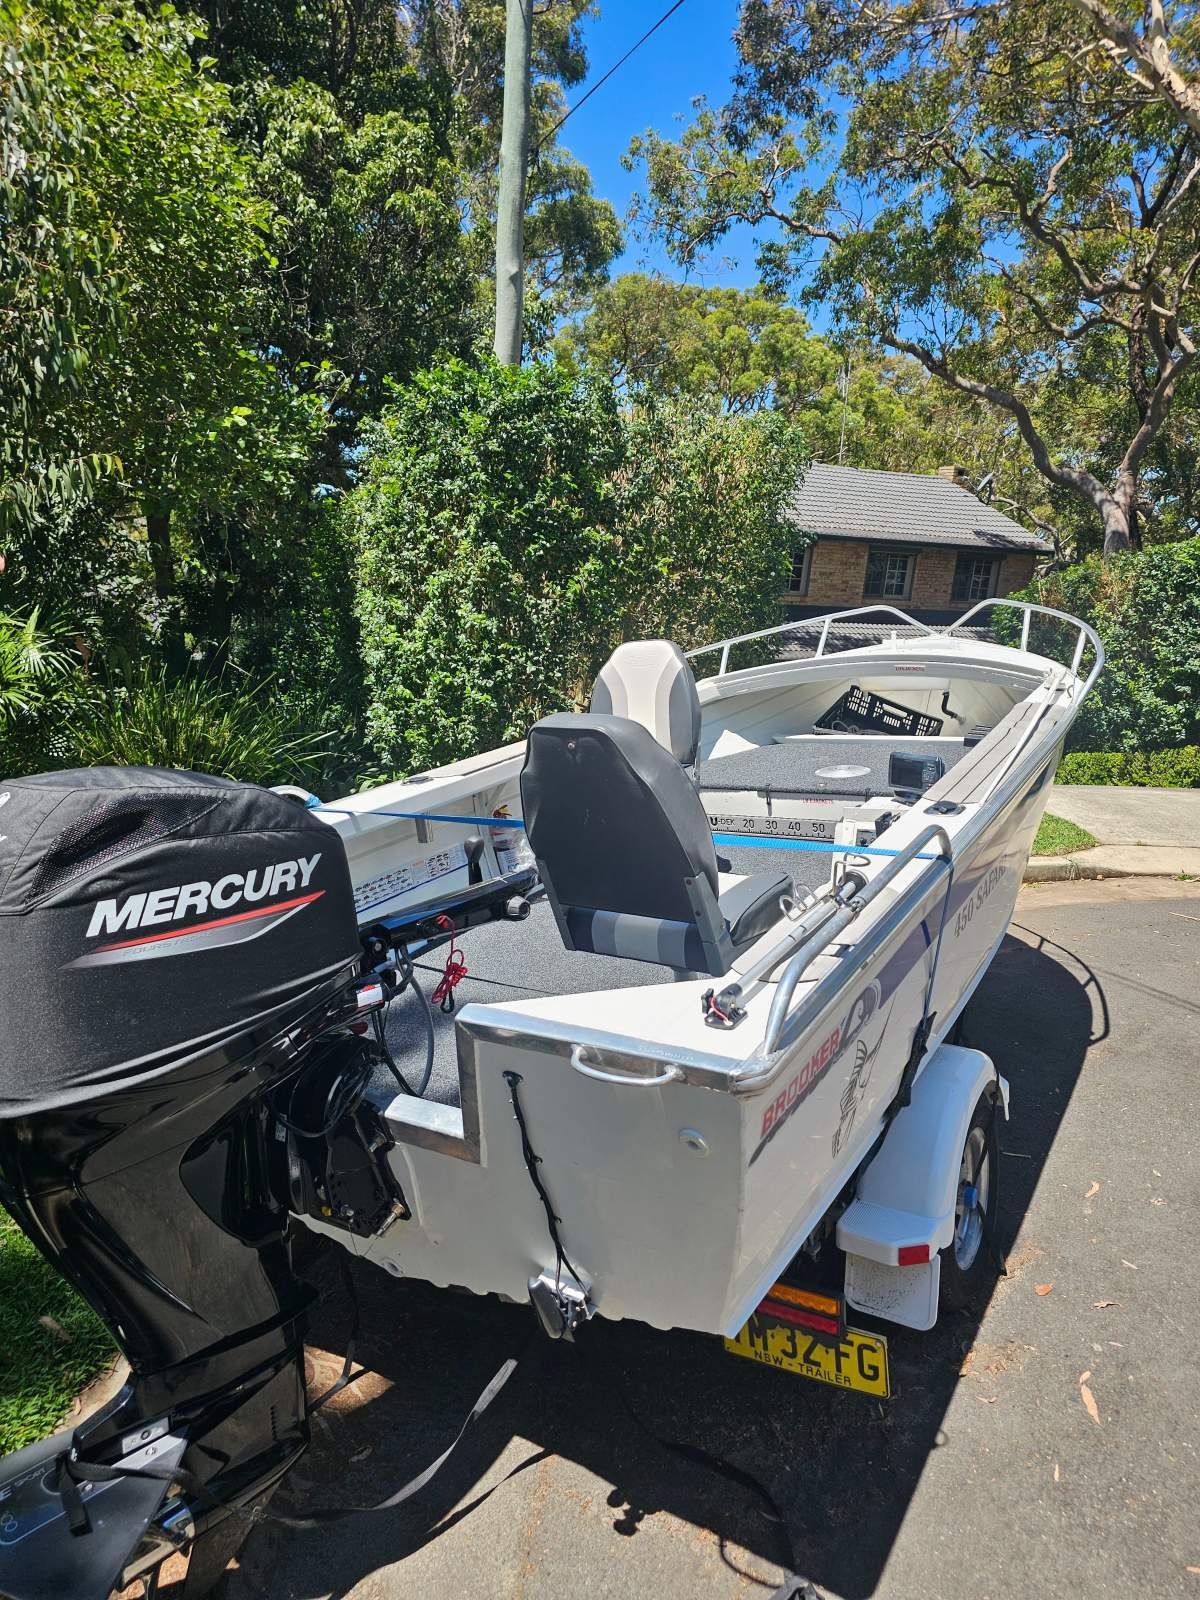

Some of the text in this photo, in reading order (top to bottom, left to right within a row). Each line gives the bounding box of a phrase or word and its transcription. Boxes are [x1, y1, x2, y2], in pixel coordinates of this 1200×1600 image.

[710, 816, 825, 833] U-DEK 20 30 40 50
[85, 852, 323, 938] MERCURY
[954, 896, 974, 938] 450
[760, 1027, 841, 1139] BROOKER
[754, 1349, 784, 1367] NSW
[798, 1362, 853, 1387] TRAILER
